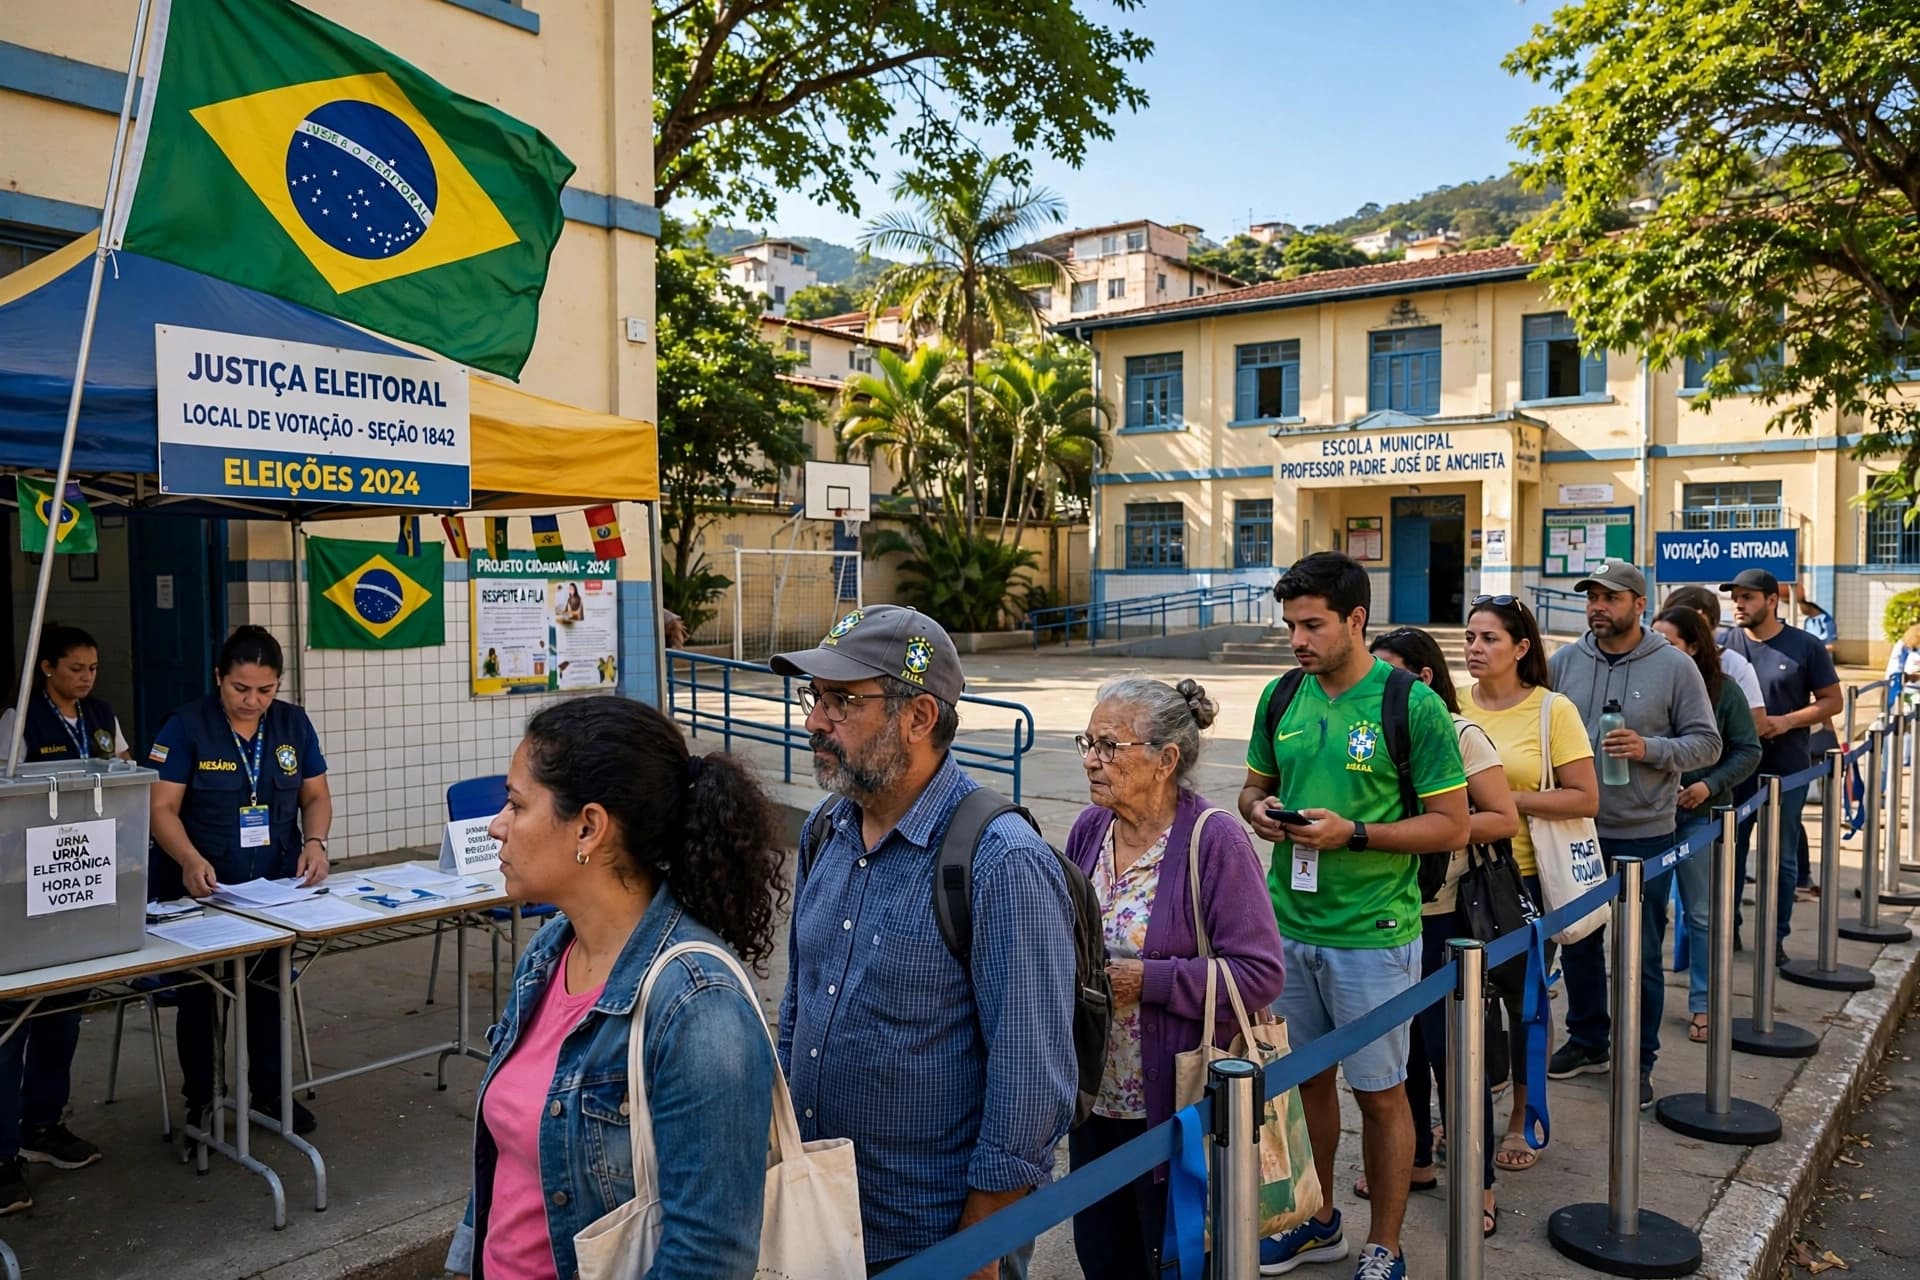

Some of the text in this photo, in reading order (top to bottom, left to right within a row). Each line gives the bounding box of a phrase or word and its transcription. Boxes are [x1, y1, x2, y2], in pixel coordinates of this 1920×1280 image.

[187, 352, 447, 408] JUSTIÇA ELEITORAL
[183, 403, 242, 428] LOCAL
[248, 409, 271, 430] DE
[275, 412, 353, 441] VOTAÇÃO
[368, 420, 418, 447] SEÇÃO
[422, 427, 455, 446] 1842
[1322, 432, 1454, 457] ESCOLA MUNICIPAL
[1280, 452, 1505, 479] PROFESSOR PADRE JOSÉ DE ANCHIETA
[224, 457, 420, 496] ELEIÇÕES 2024
[1662, 539, 1719, 564] VOTAÇÃO
[1730, 541, 1789, 559] ENTRADA
[476, 559, 523, 573] PROJETO
[587, 560, 610, 574] 2024
[520, 589, 526, 603] A
[198, 758, 237, 771] MESÁRIO
[56, 834, 90, 847] URNA
[52, 846, 90, 861] URNA
[42, 874, 102, 893] HORA DE
[48, 889, 94, 906] VOTAR
